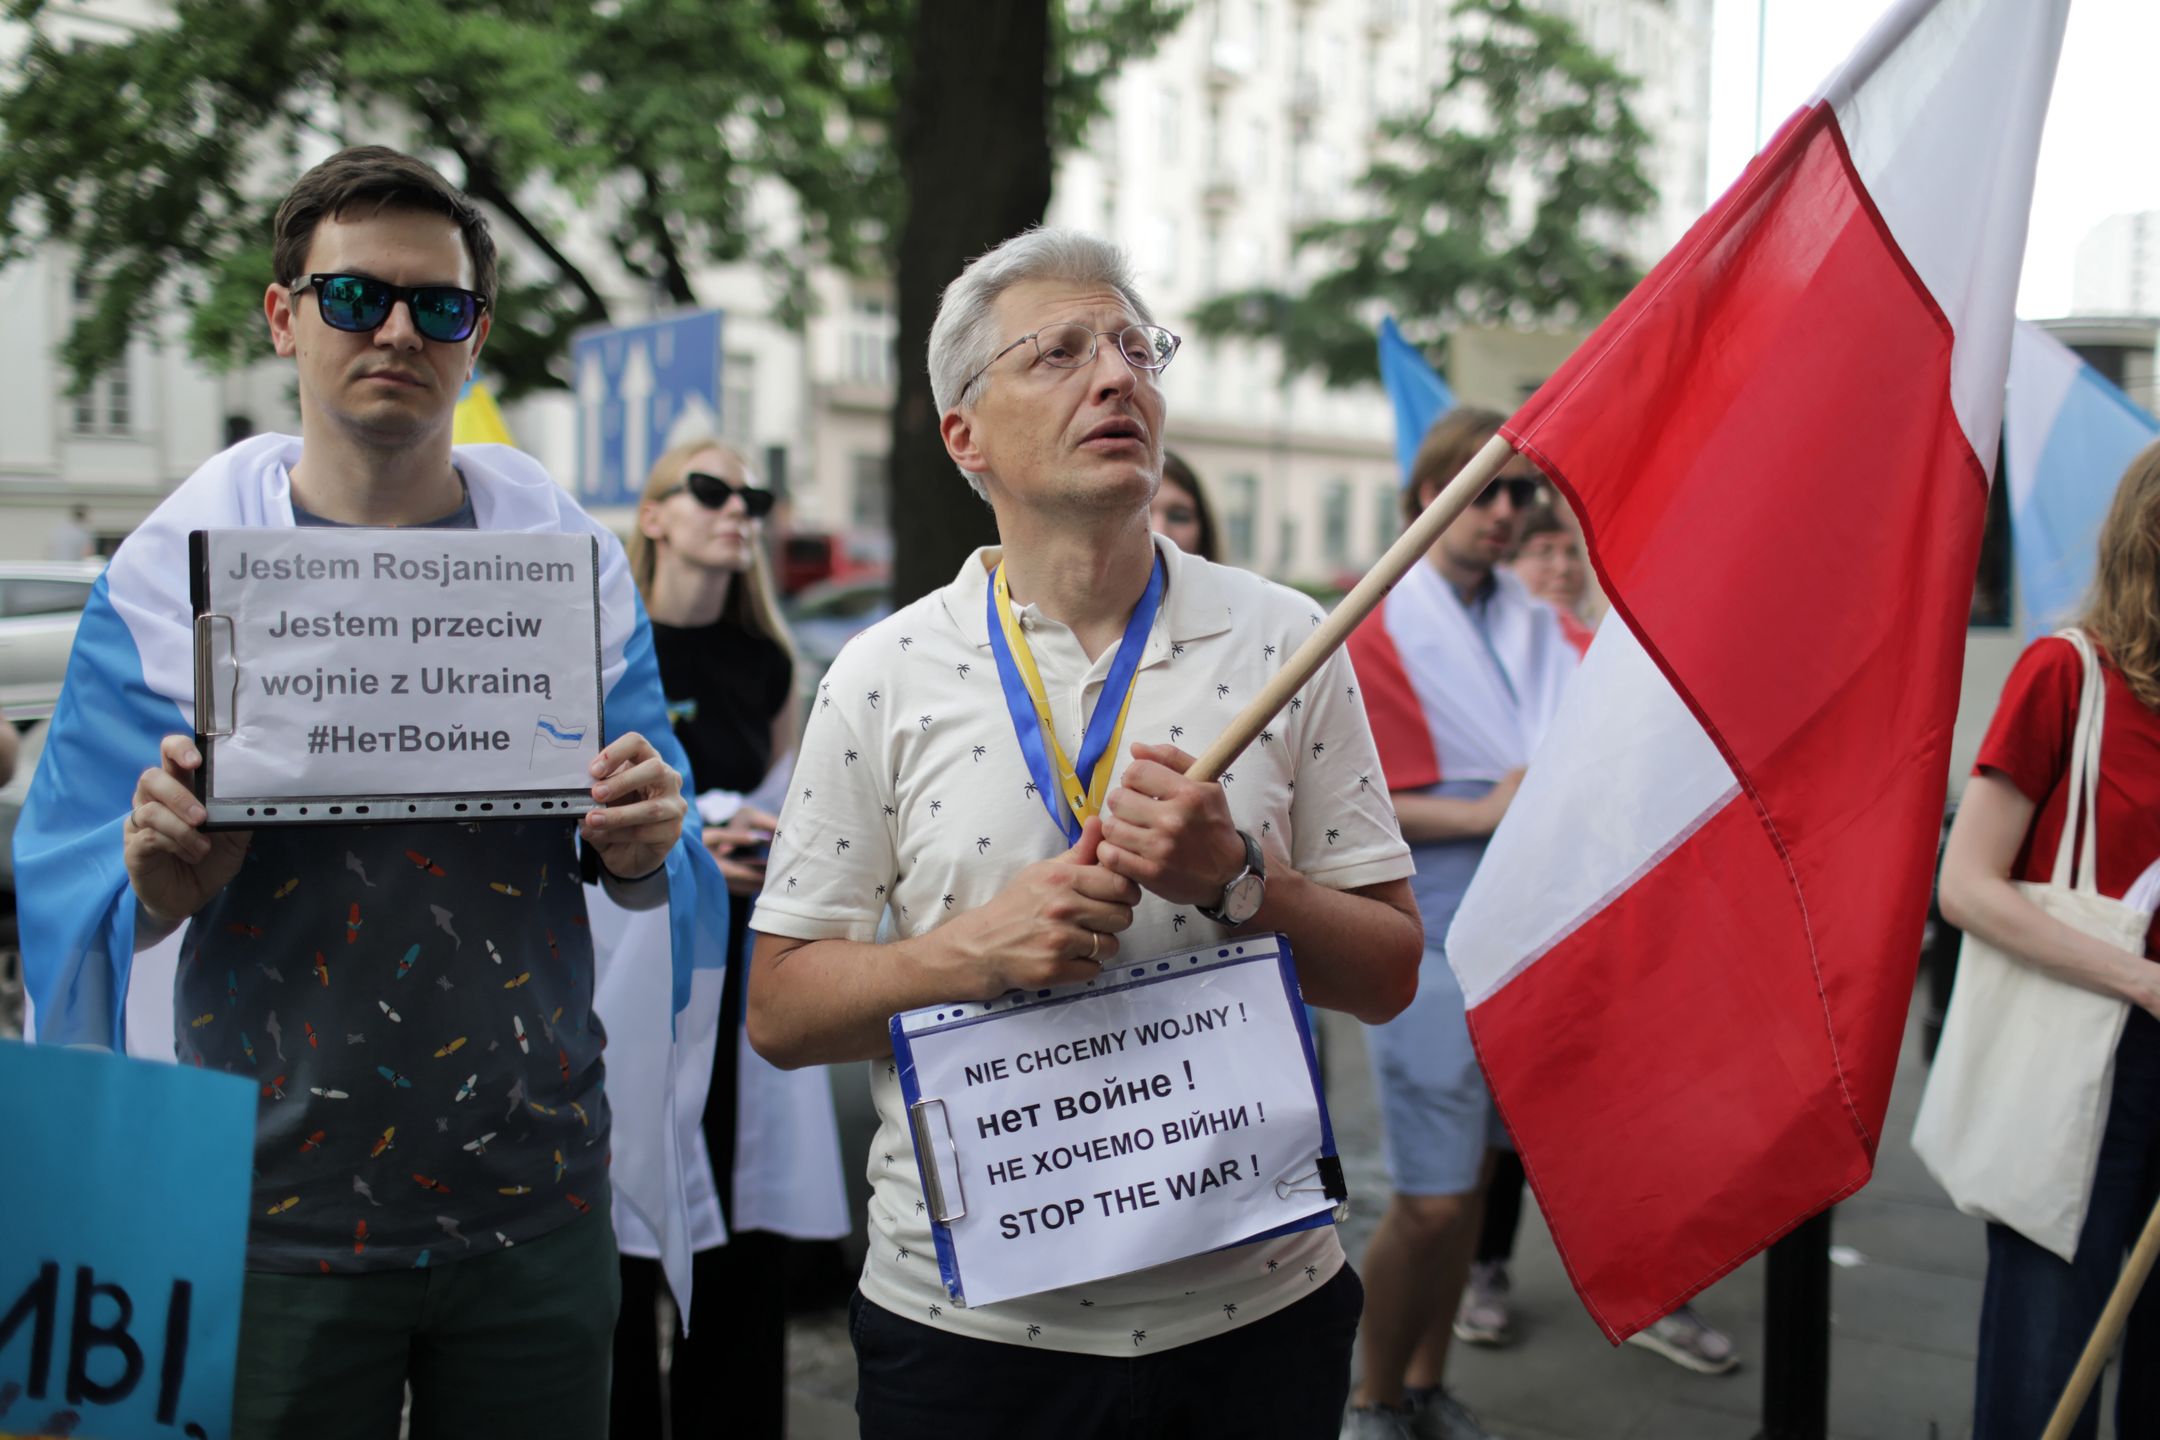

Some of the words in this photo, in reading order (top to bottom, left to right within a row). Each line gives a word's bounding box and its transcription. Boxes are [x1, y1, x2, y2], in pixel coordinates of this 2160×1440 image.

[228, 552, 360, 581] Jestem
[373, 552, 575, 588] Rosjaninem
[268, 610, 399, 638] Jestem
[411, 610, 543, 644] przeciw
[260, 667, 380, 703] wojnie
[390, 674, 410, 695] z
[420, 666, 553, 701] Ukrainą
[307, 723, 511, 755] #НетВойне
[963, 1057, 1010, 1087] NIE
[1015, 1029, 1128, 1075] CHCEMY
[1133, 1005, 1230, 1047] WOJNY
[1238, 1001, 1248, 1023] !
[976, 1102, 1042, 1140] нет
[1053, 1073, 1173, 1122] войне
[1182, 1059, 1196, 1091] !
[986, 1156, 1028, 1186] НЕ
[1031, 1127, 1155, 1176] ХОЧЕМО
[1160, 1104, 1250, 1146] ВІЙНИ
[1256, 1101, 1266, 1124] !
[999, 1197, 1085, 1240] STOP
[1092, 1180, 1160, 1218] THE
[1164, 1158, 1242, 1202] WAR
[1250, 1153, 1261, 1178] !
